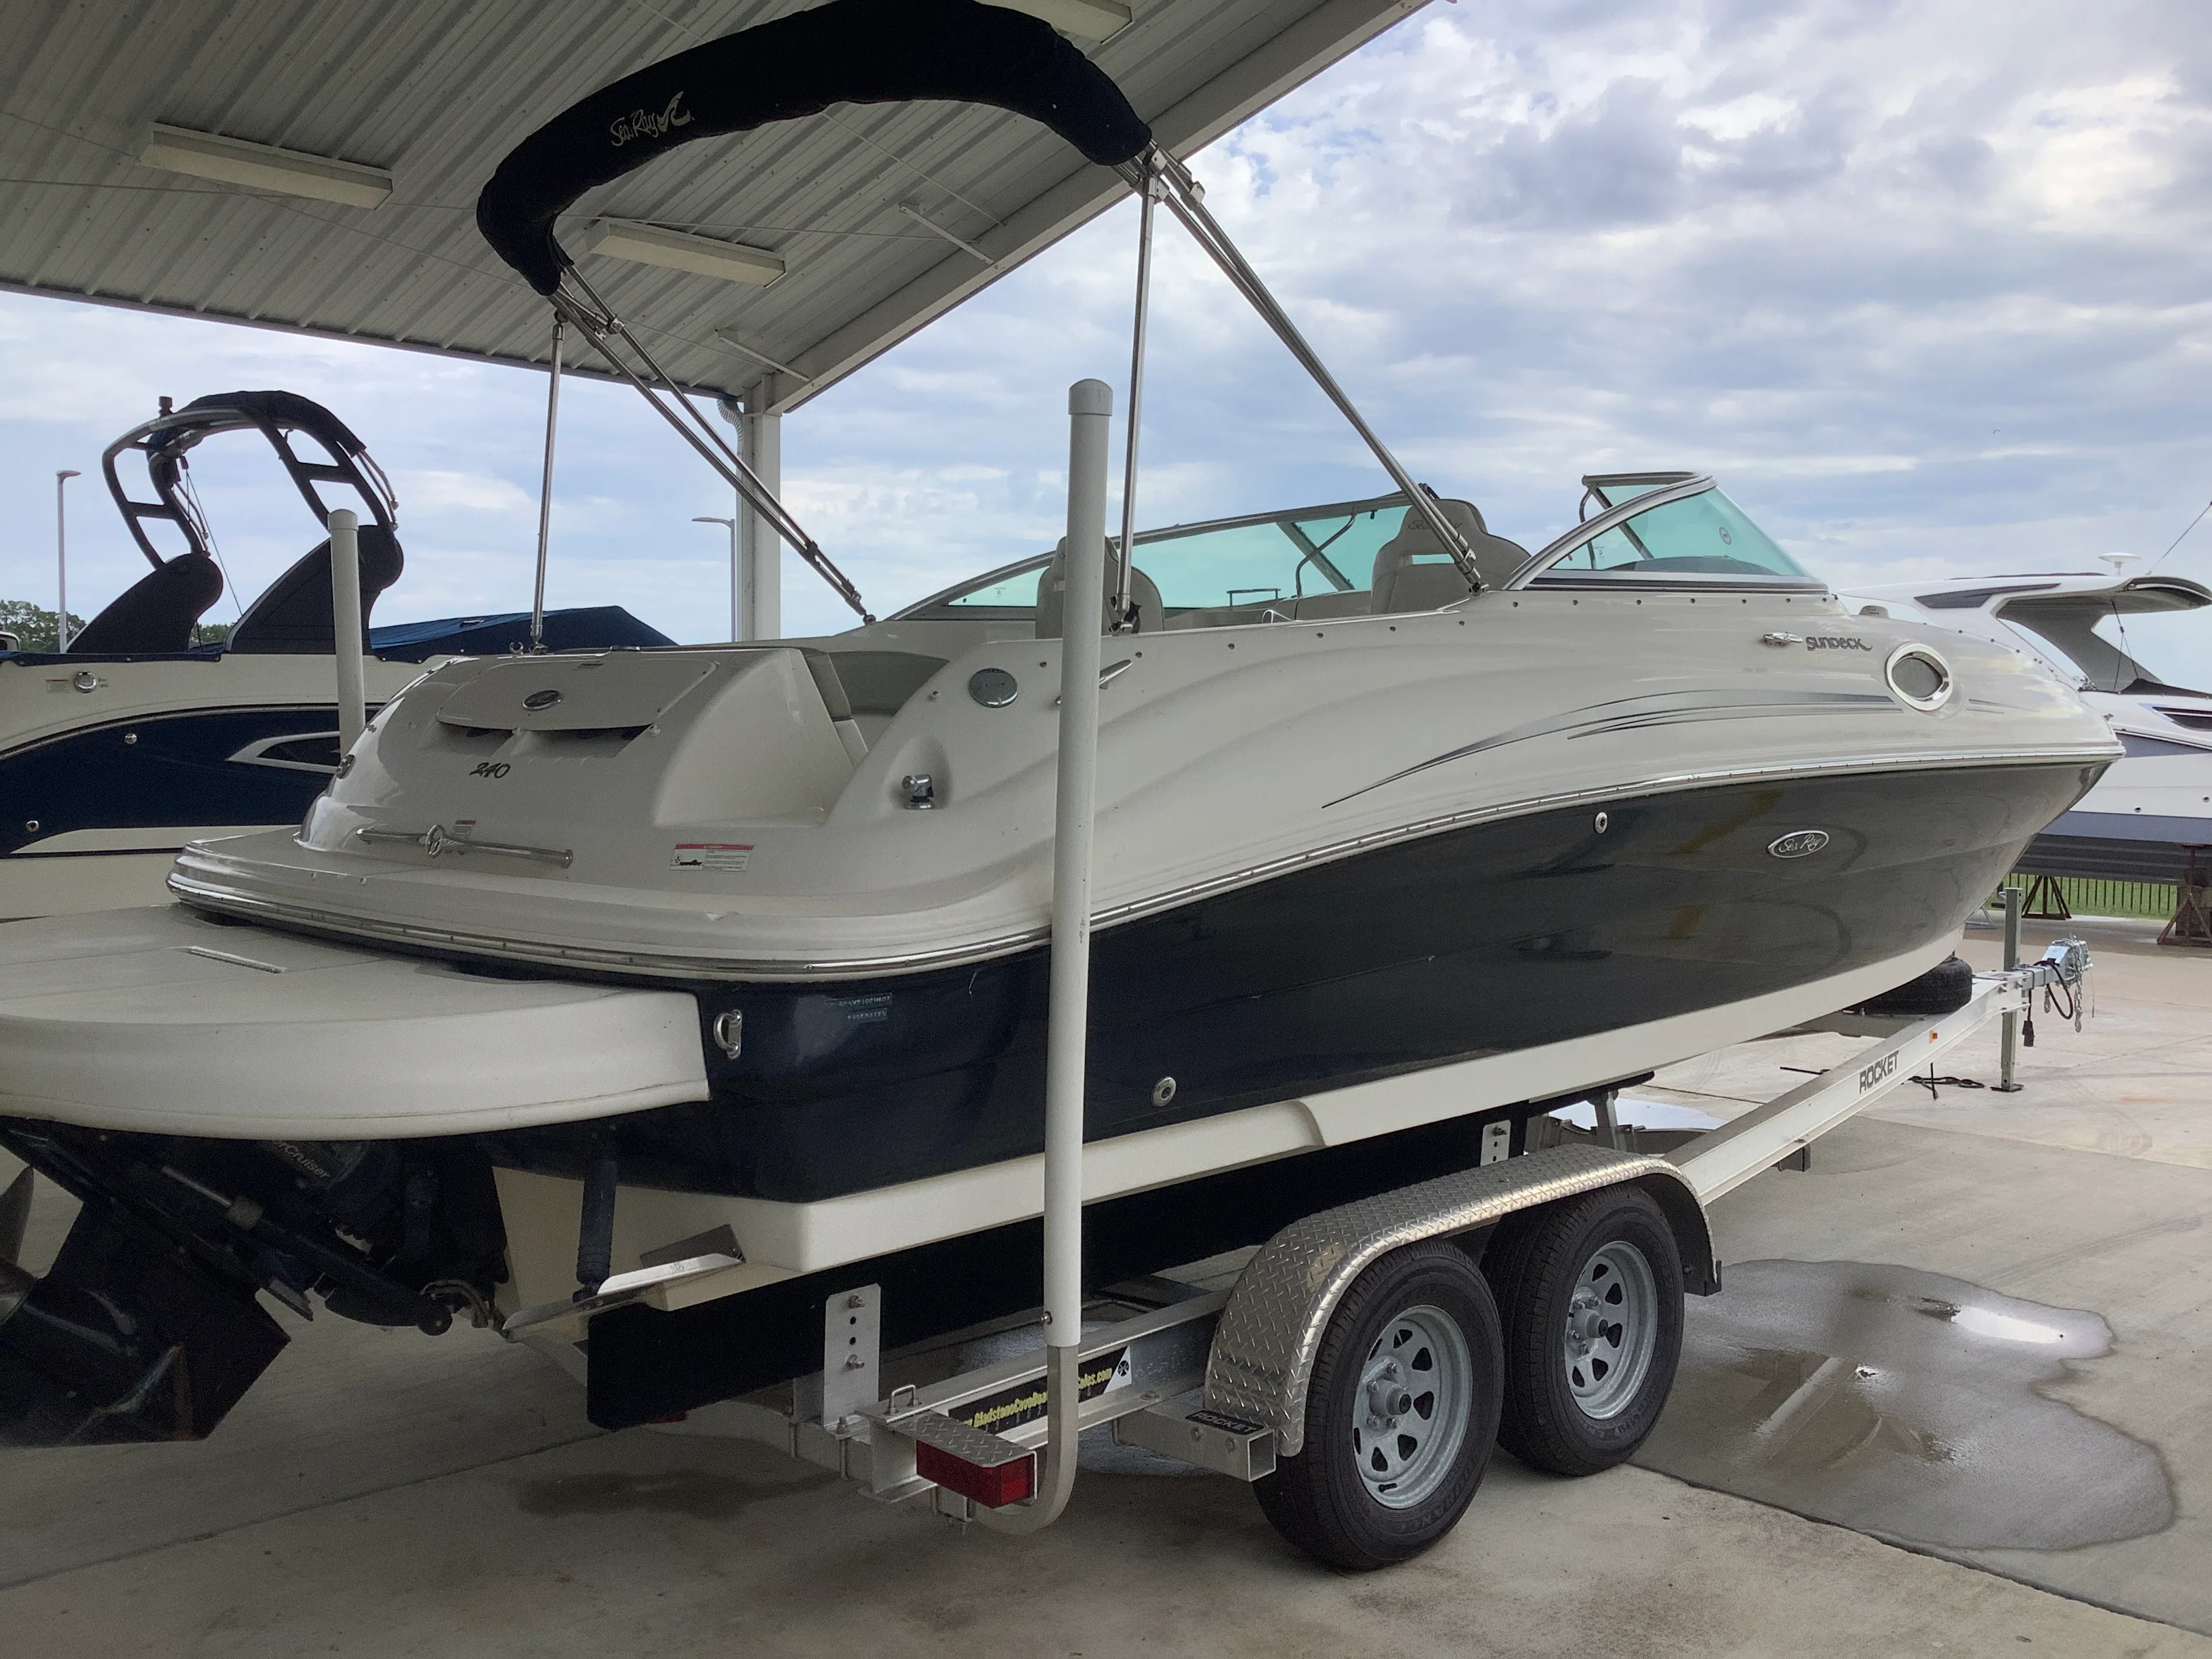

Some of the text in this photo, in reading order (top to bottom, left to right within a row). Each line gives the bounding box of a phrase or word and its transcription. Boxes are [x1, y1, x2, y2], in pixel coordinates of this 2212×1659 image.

[610, 109, 659, 146] Sea Ray
[468, 762, 511, 779] 240
[1778, 834, 1822, 853] Sea Ray
[1859, 1050, 1899, 1094] ROCKET
[1191, 1412, 1258, 1432] ROCKET
